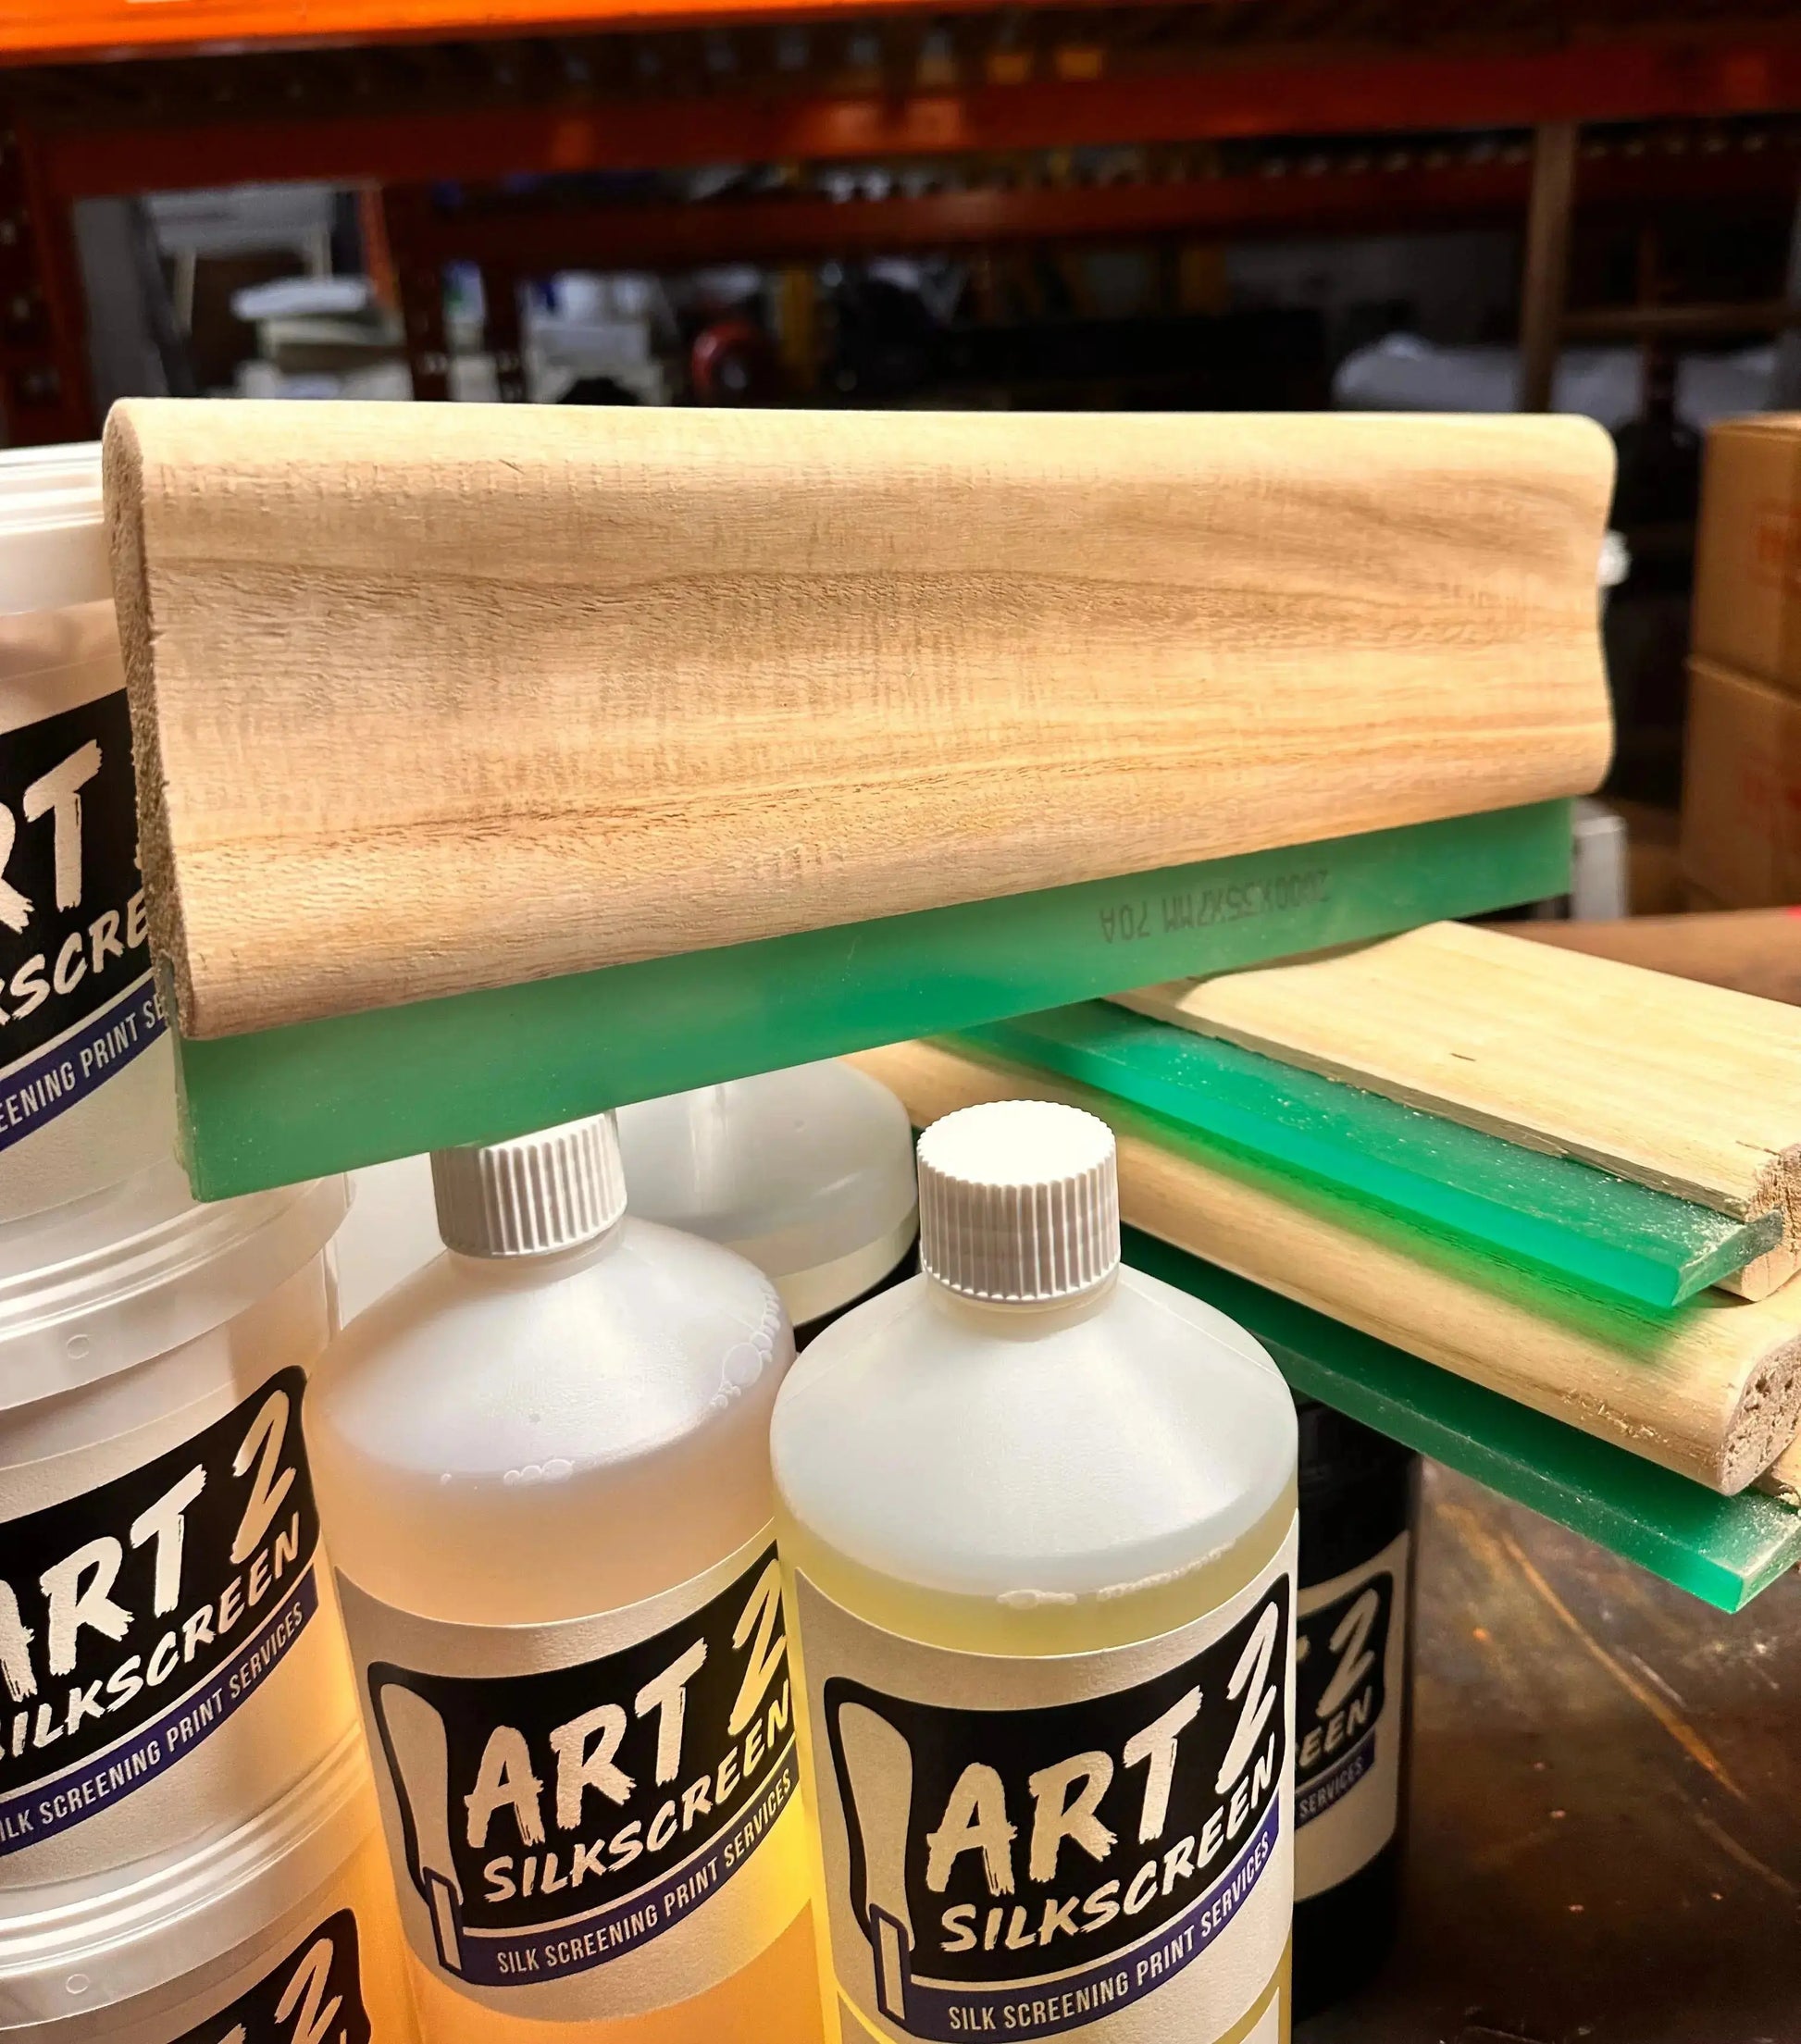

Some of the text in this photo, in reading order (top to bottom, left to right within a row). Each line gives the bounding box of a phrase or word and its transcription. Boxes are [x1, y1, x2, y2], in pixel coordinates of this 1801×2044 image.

[1099, 899, 1151, 945] 70A
[80, 1016, 137, 1074] PRINT
[230, 1390, 295, 1564] 2
[0, 1512, 302, 1760] ILKSCREEN
[0, 1601, 304, 1842] ILK SCREENING PRINT SERVICES
[464, 1557, 787, 1849] ART 2
[1296, 1685, 1372, 1769] EEN
[1315, 1588, 1380, 1718] 2
[483, 1679, 790, 1903] SILKSCREEN
[925, 1601, 1279, 1897] ART 2
[939, 1731, 1275, 1953] SILKSCREEN
[1298, 1755, 1365, 1819] SERVICES
[497, 1768, 792, 1975] SILK SCREENING PRINT SERVICES
[948, 1831, 1270, 2031] SILK SCREENING PRINT SERVICES
